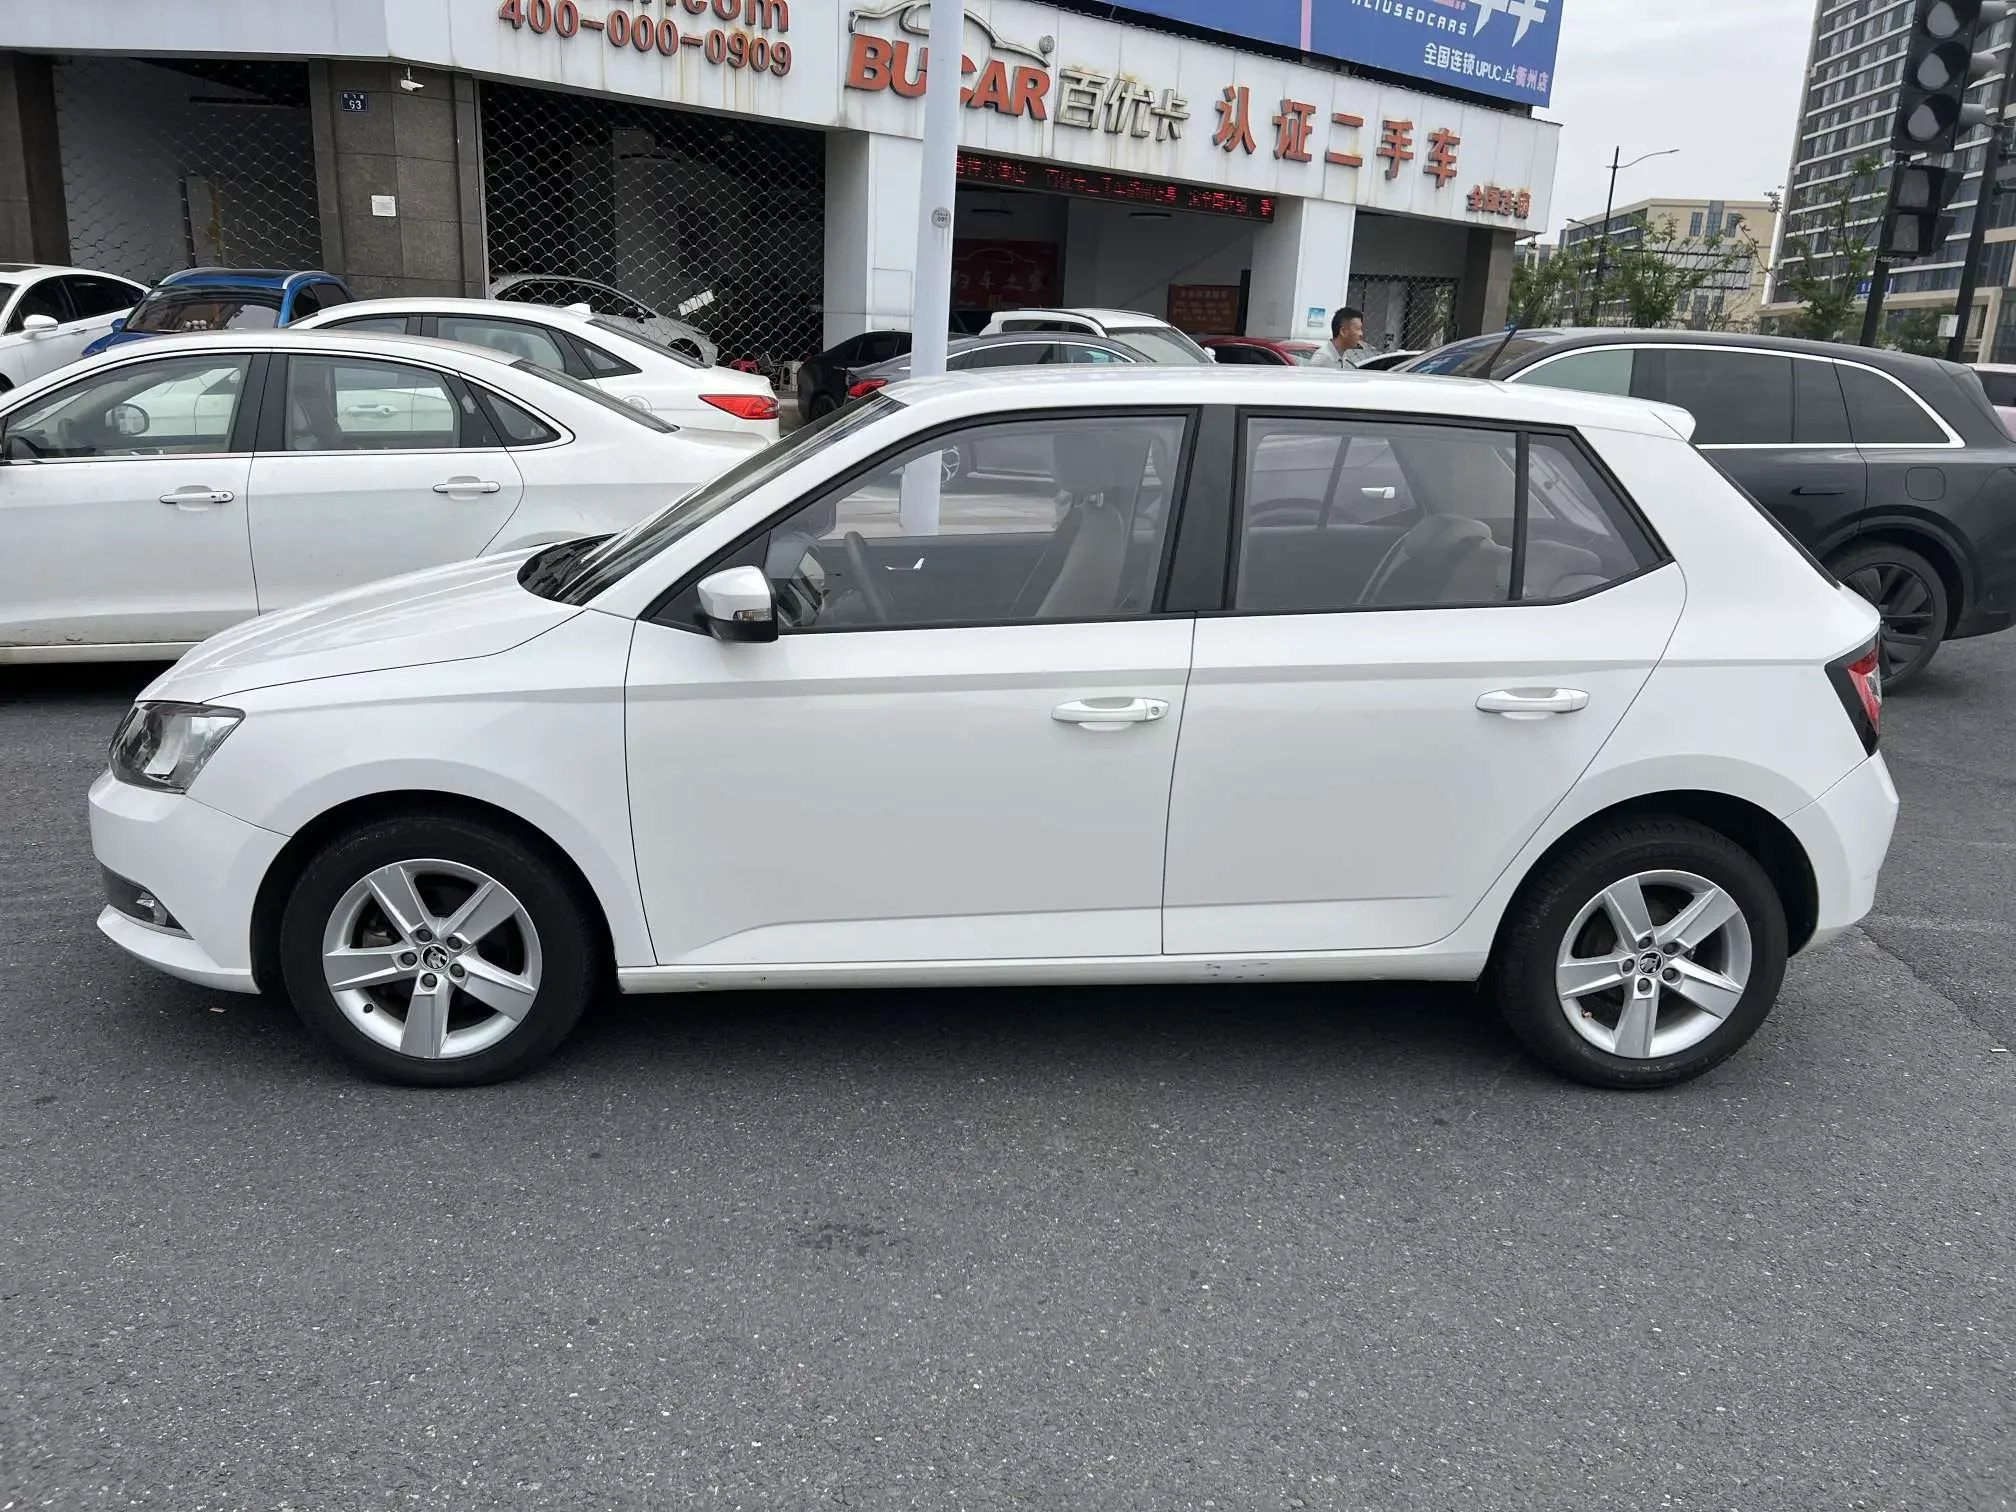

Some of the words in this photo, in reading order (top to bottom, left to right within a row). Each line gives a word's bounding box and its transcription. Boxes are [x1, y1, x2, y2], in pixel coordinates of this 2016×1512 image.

[498, 0, 792, 77] 400-000-0909
[1423, 42, 1476, 76] 全国连锁
[349, 99, 362, 110] 63
[1053, 67, 1192, 142] 百优卡
[1212, 85, 1461, 189] 认证二手车
